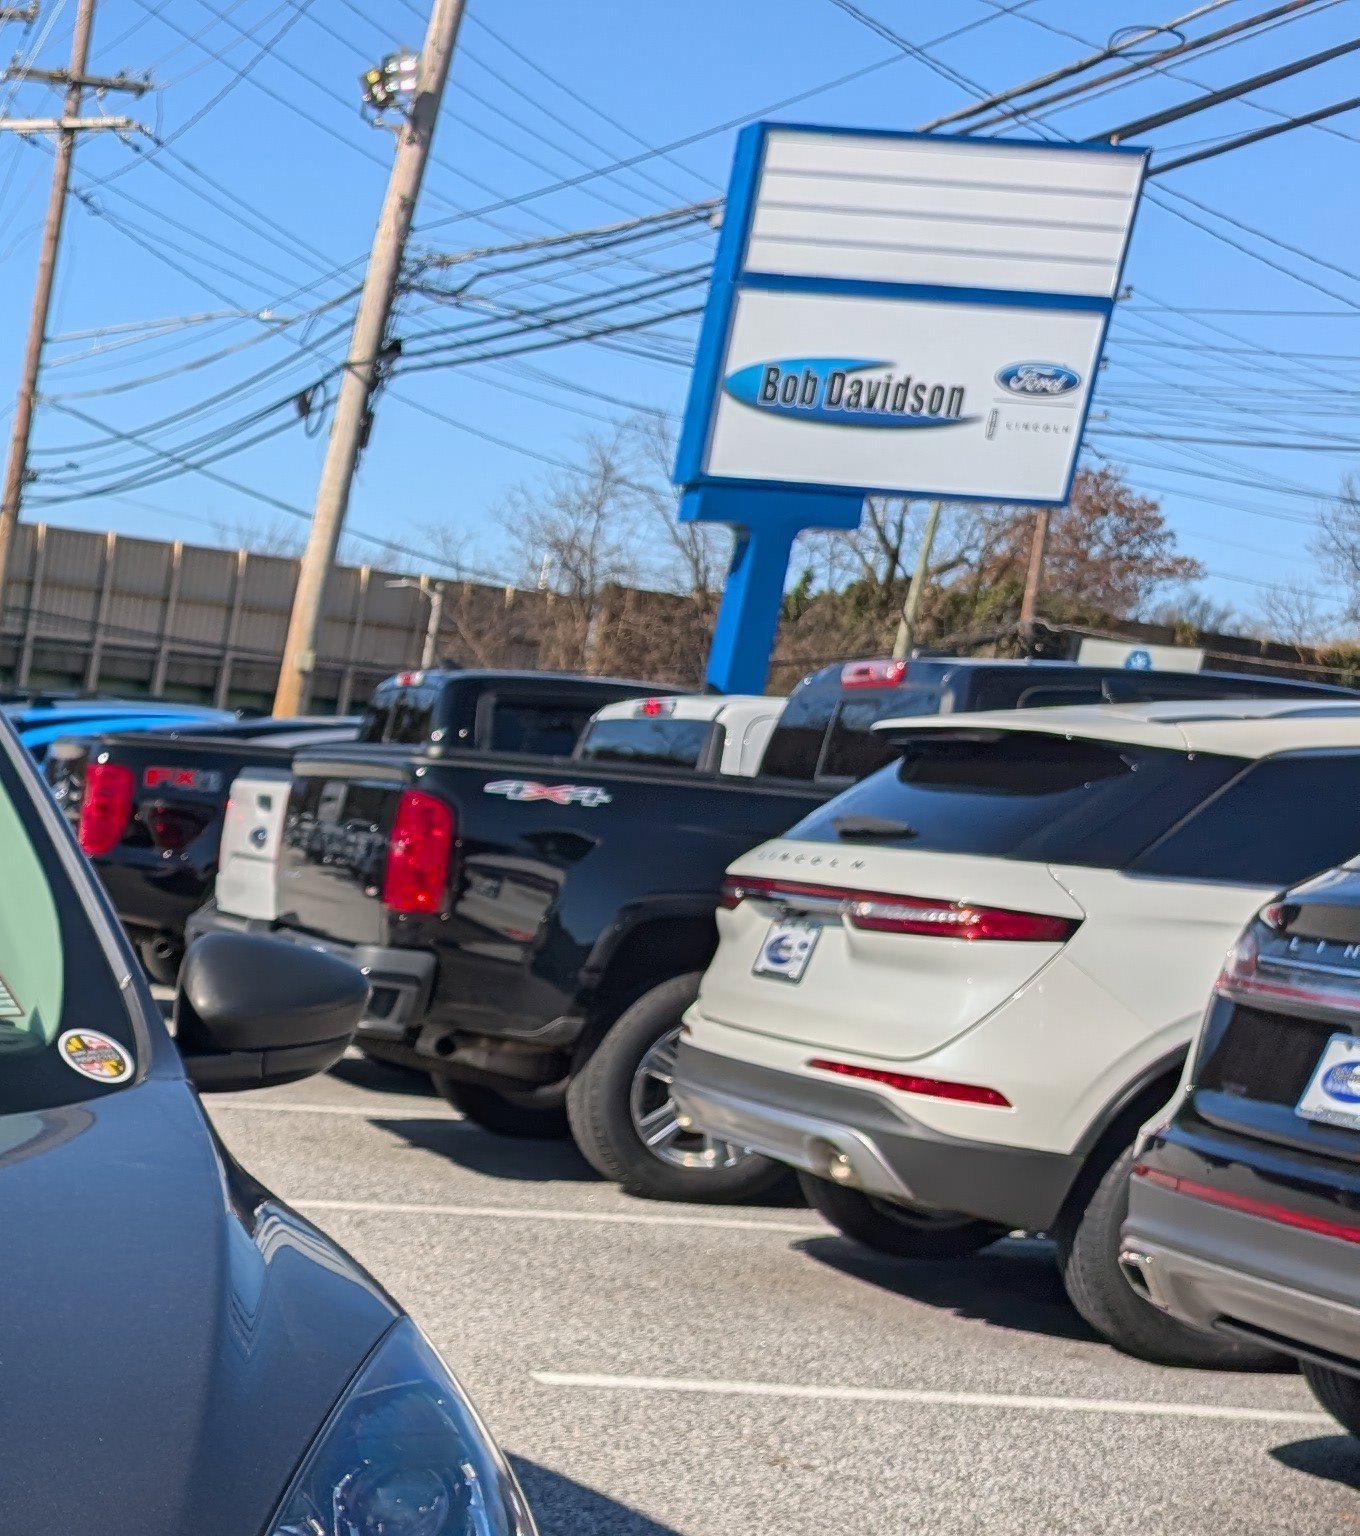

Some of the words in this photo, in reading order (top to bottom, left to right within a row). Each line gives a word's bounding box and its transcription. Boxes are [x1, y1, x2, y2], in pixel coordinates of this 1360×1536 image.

[760, 366, 818, 408] Bob
[825, 371, 966, 418] Davidson
[1009, 364, 1068, 394] Ford
[1005, 421, 1070, 434] LINCOLN
